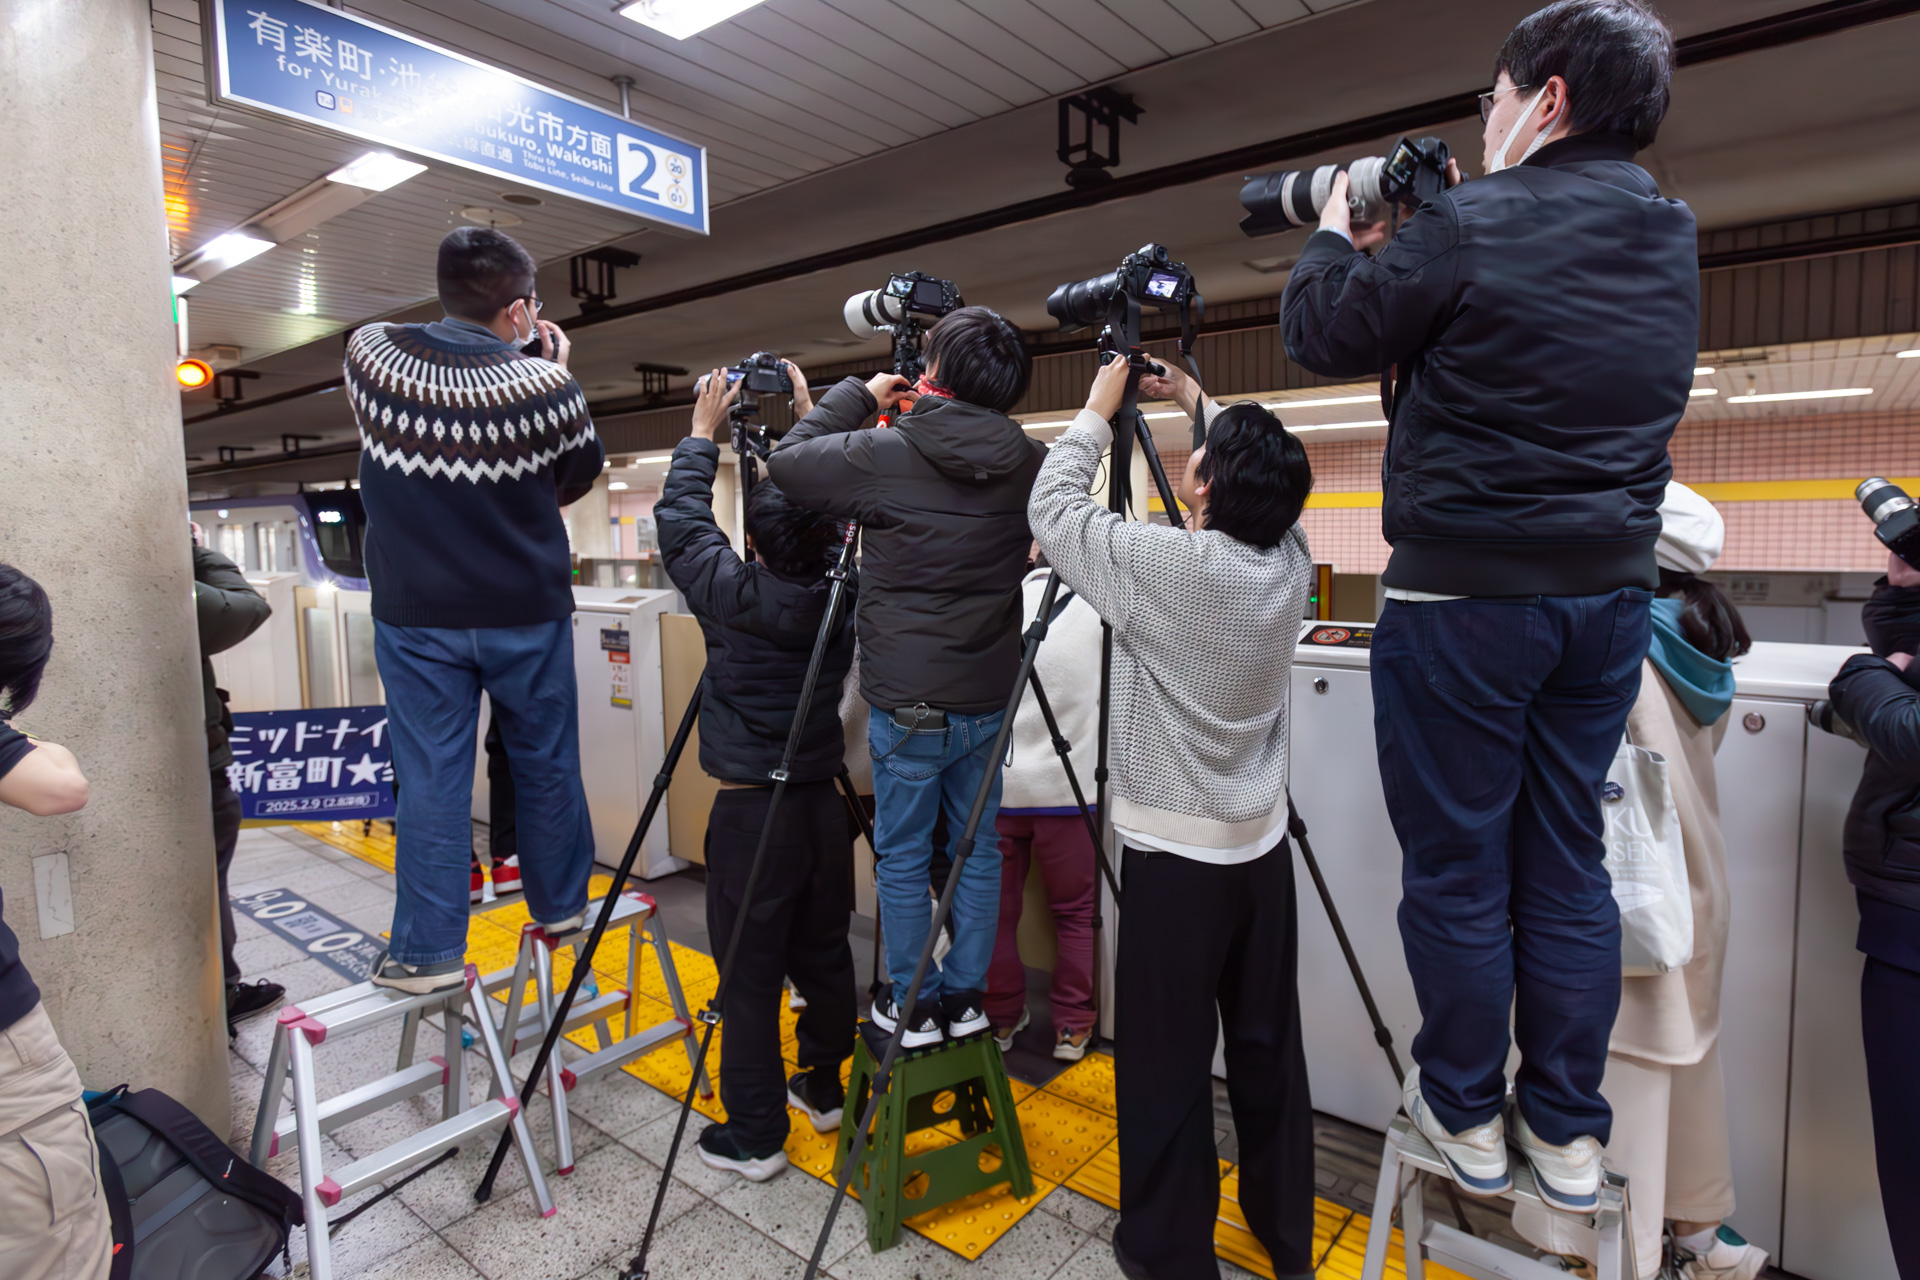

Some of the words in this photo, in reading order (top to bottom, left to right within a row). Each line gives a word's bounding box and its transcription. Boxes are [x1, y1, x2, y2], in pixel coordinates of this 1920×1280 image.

[276, 55, 312, 80] for
[546, 141, 613, 176] Wakoshi
[522, 149, 544, 164] Thru
[546, 157, 556, 167] to
[522, 158, 546, 173] Tobu
[547, 166, 569, 180] Line,
[570, 172, 595, 188] Seibu
[596, 181, 614, 193] Line
[628, 143, 659, 200] 2
[670, 162, 682, 174] 20
[670, 193, 682, 204] 01
[264, 798, 321, 813] 2025.2.9
